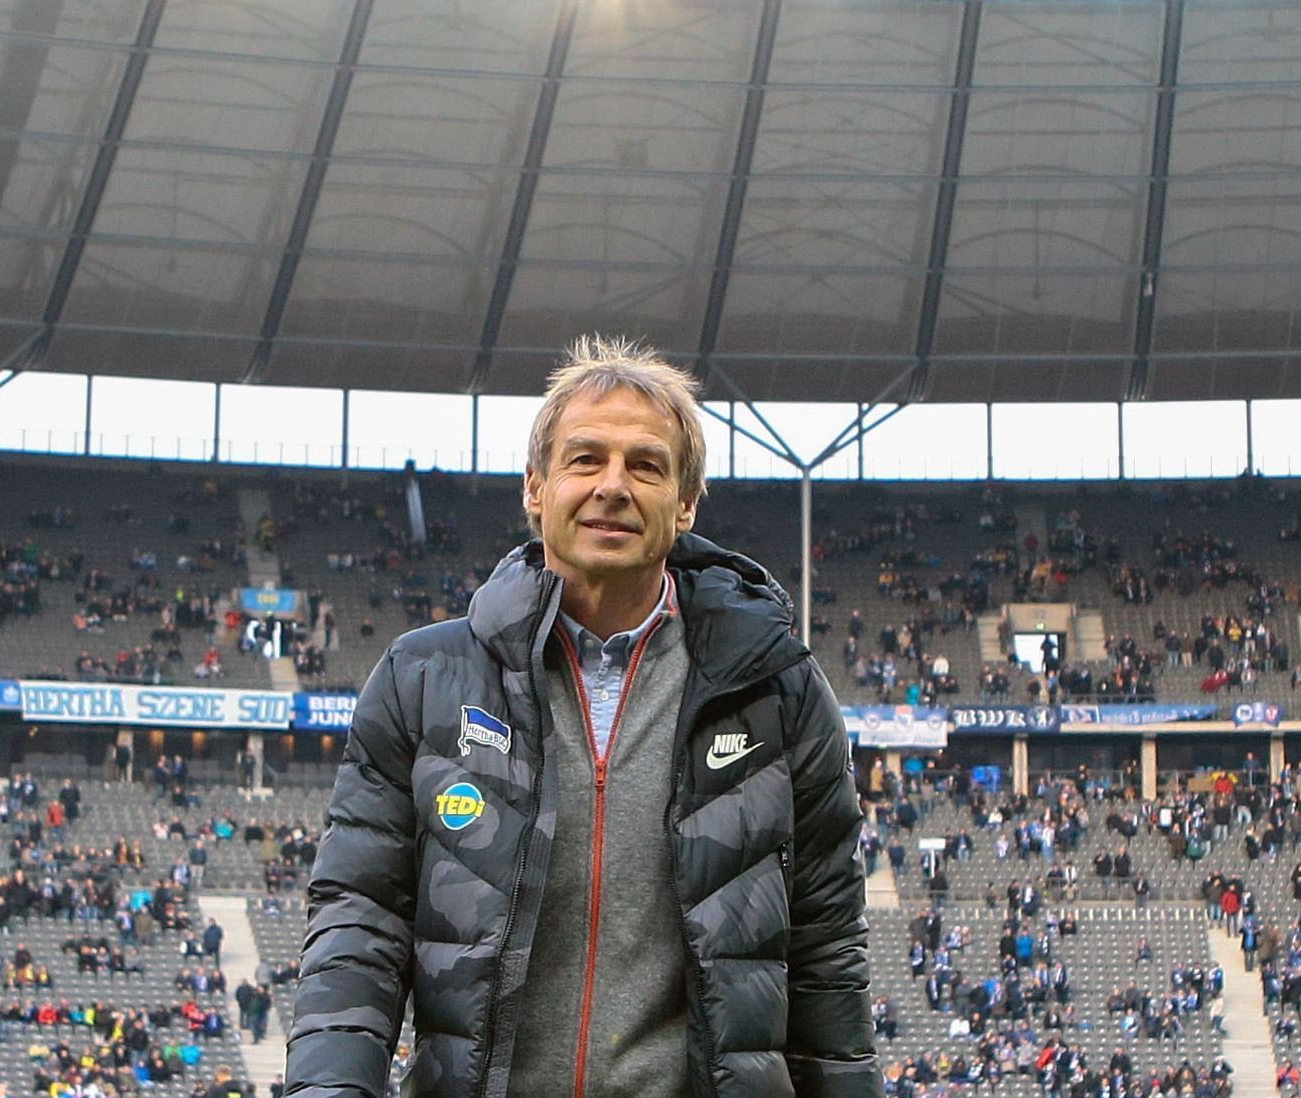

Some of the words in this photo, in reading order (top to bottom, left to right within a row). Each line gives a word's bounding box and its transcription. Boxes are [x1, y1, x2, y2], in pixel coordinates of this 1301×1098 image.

[23, 686, 126, 717] HERTHA
[138, 691, 226, 722] SZENE
[307, 711, 355, 726] JUN
[712, 733, 749, 754] NIKE
[436, 794, 486, 818] TEDi
